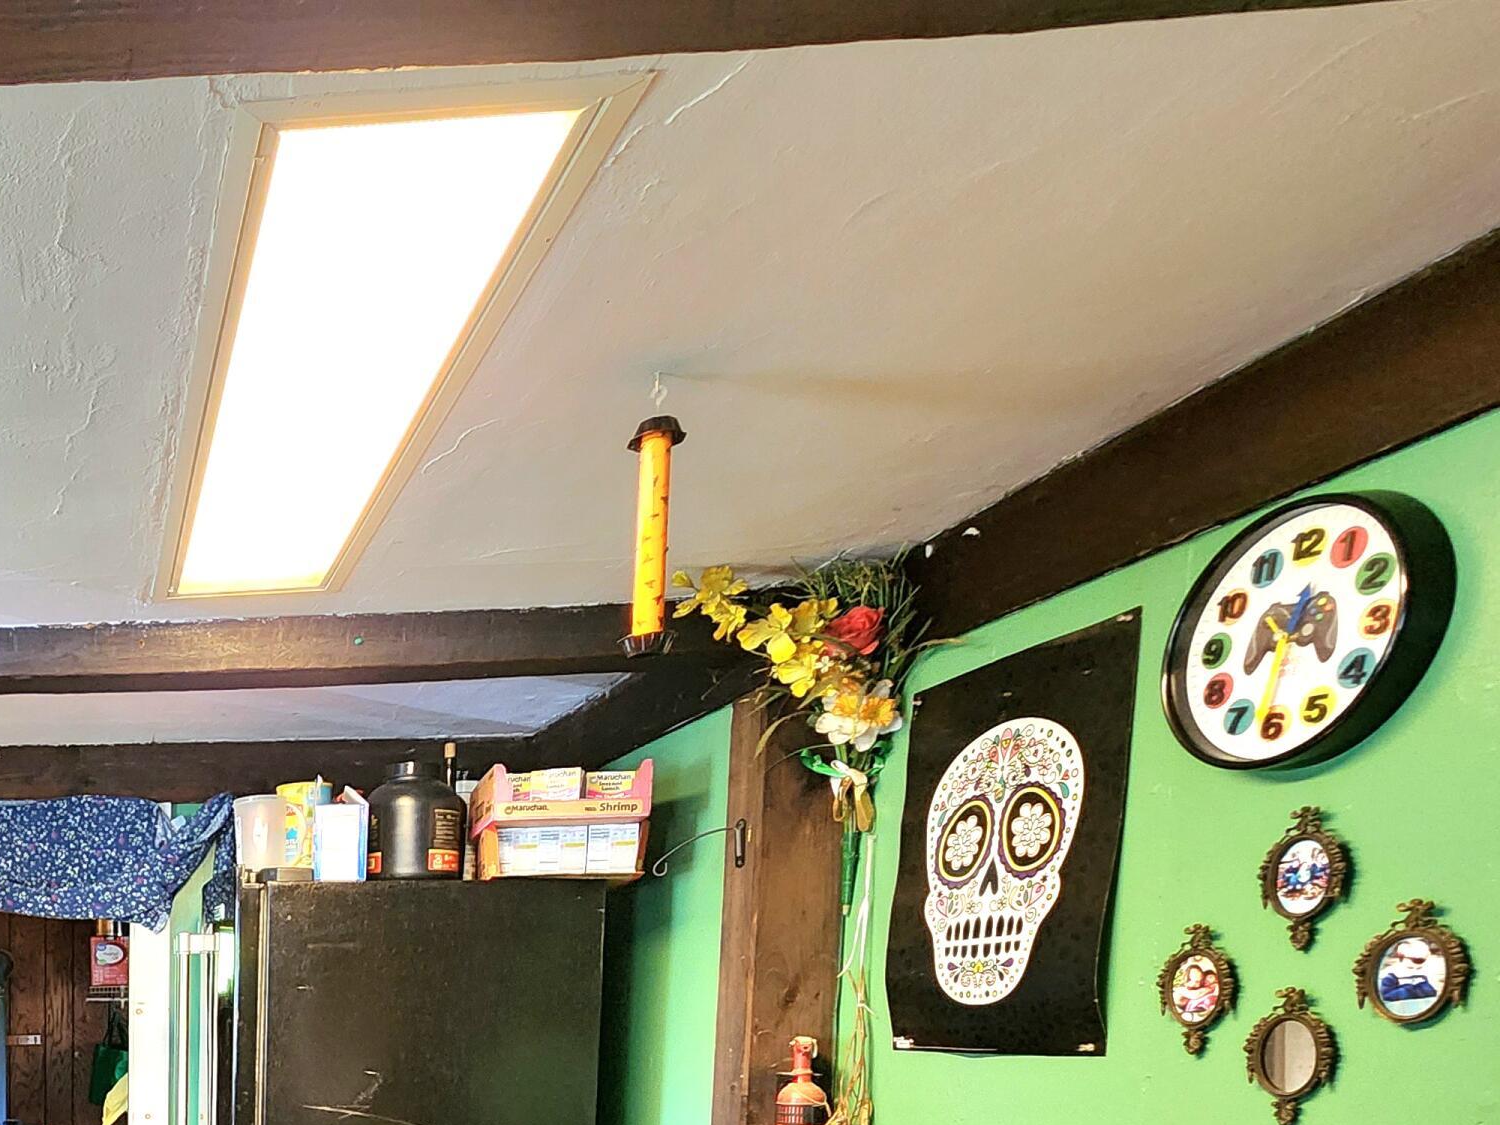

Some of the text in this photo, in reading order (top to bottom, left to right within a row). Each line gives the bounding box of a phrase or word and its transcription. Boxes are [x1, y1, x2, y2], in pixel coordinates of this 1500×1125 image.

[1291, 528, 1326, 561] 12
[1341, 530, 1358, 561] 1
[1252, 556, 1278, 585] 11
[1360, 557, 1390, 590] 2
[1217, 592, 1249, 622] 10
[1364, 605, 1392, 635] 3
[1202, 639, 1224, 665] 9
[1340, 654, 1367, 685] 4
[1204, 680, 1226, 706] 8
[1227, 706, 1249, 735] 7
[1303, 694, 1329, 723] 5
[1260, 713, 1285, 740] 6
[597, 773, 632, 782] Maruchan
[511, 803, 549, 812] Maruchan
[600, 802, 638, 813] Shrimp
